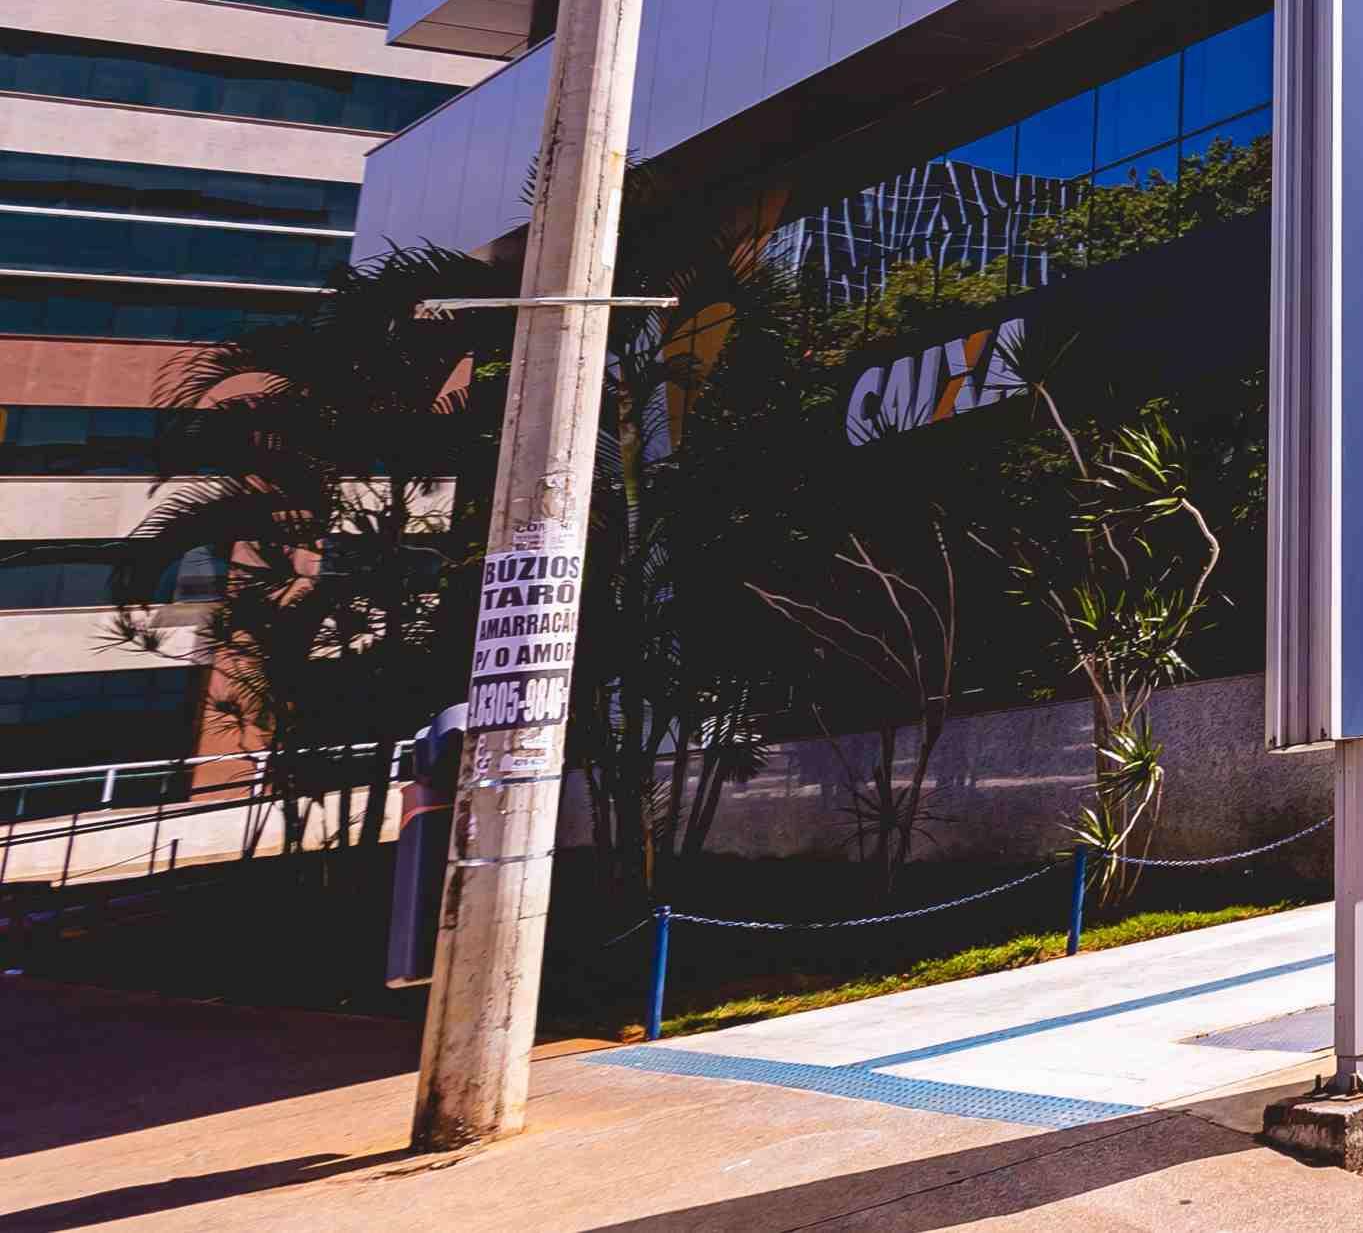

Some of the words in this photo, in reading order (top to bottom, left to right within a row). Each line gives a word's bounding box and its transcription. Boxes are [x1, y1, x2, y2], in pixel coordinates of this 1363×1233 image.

[846, 318, 1029, 446] CAIXA
[484, 554, 580, 585] BÚZIOS
[483, 580, 575, 610] TARÔ
[480, 608, 575, 641] AMARRAÇÃ
[495, 646, 510, 668] O
